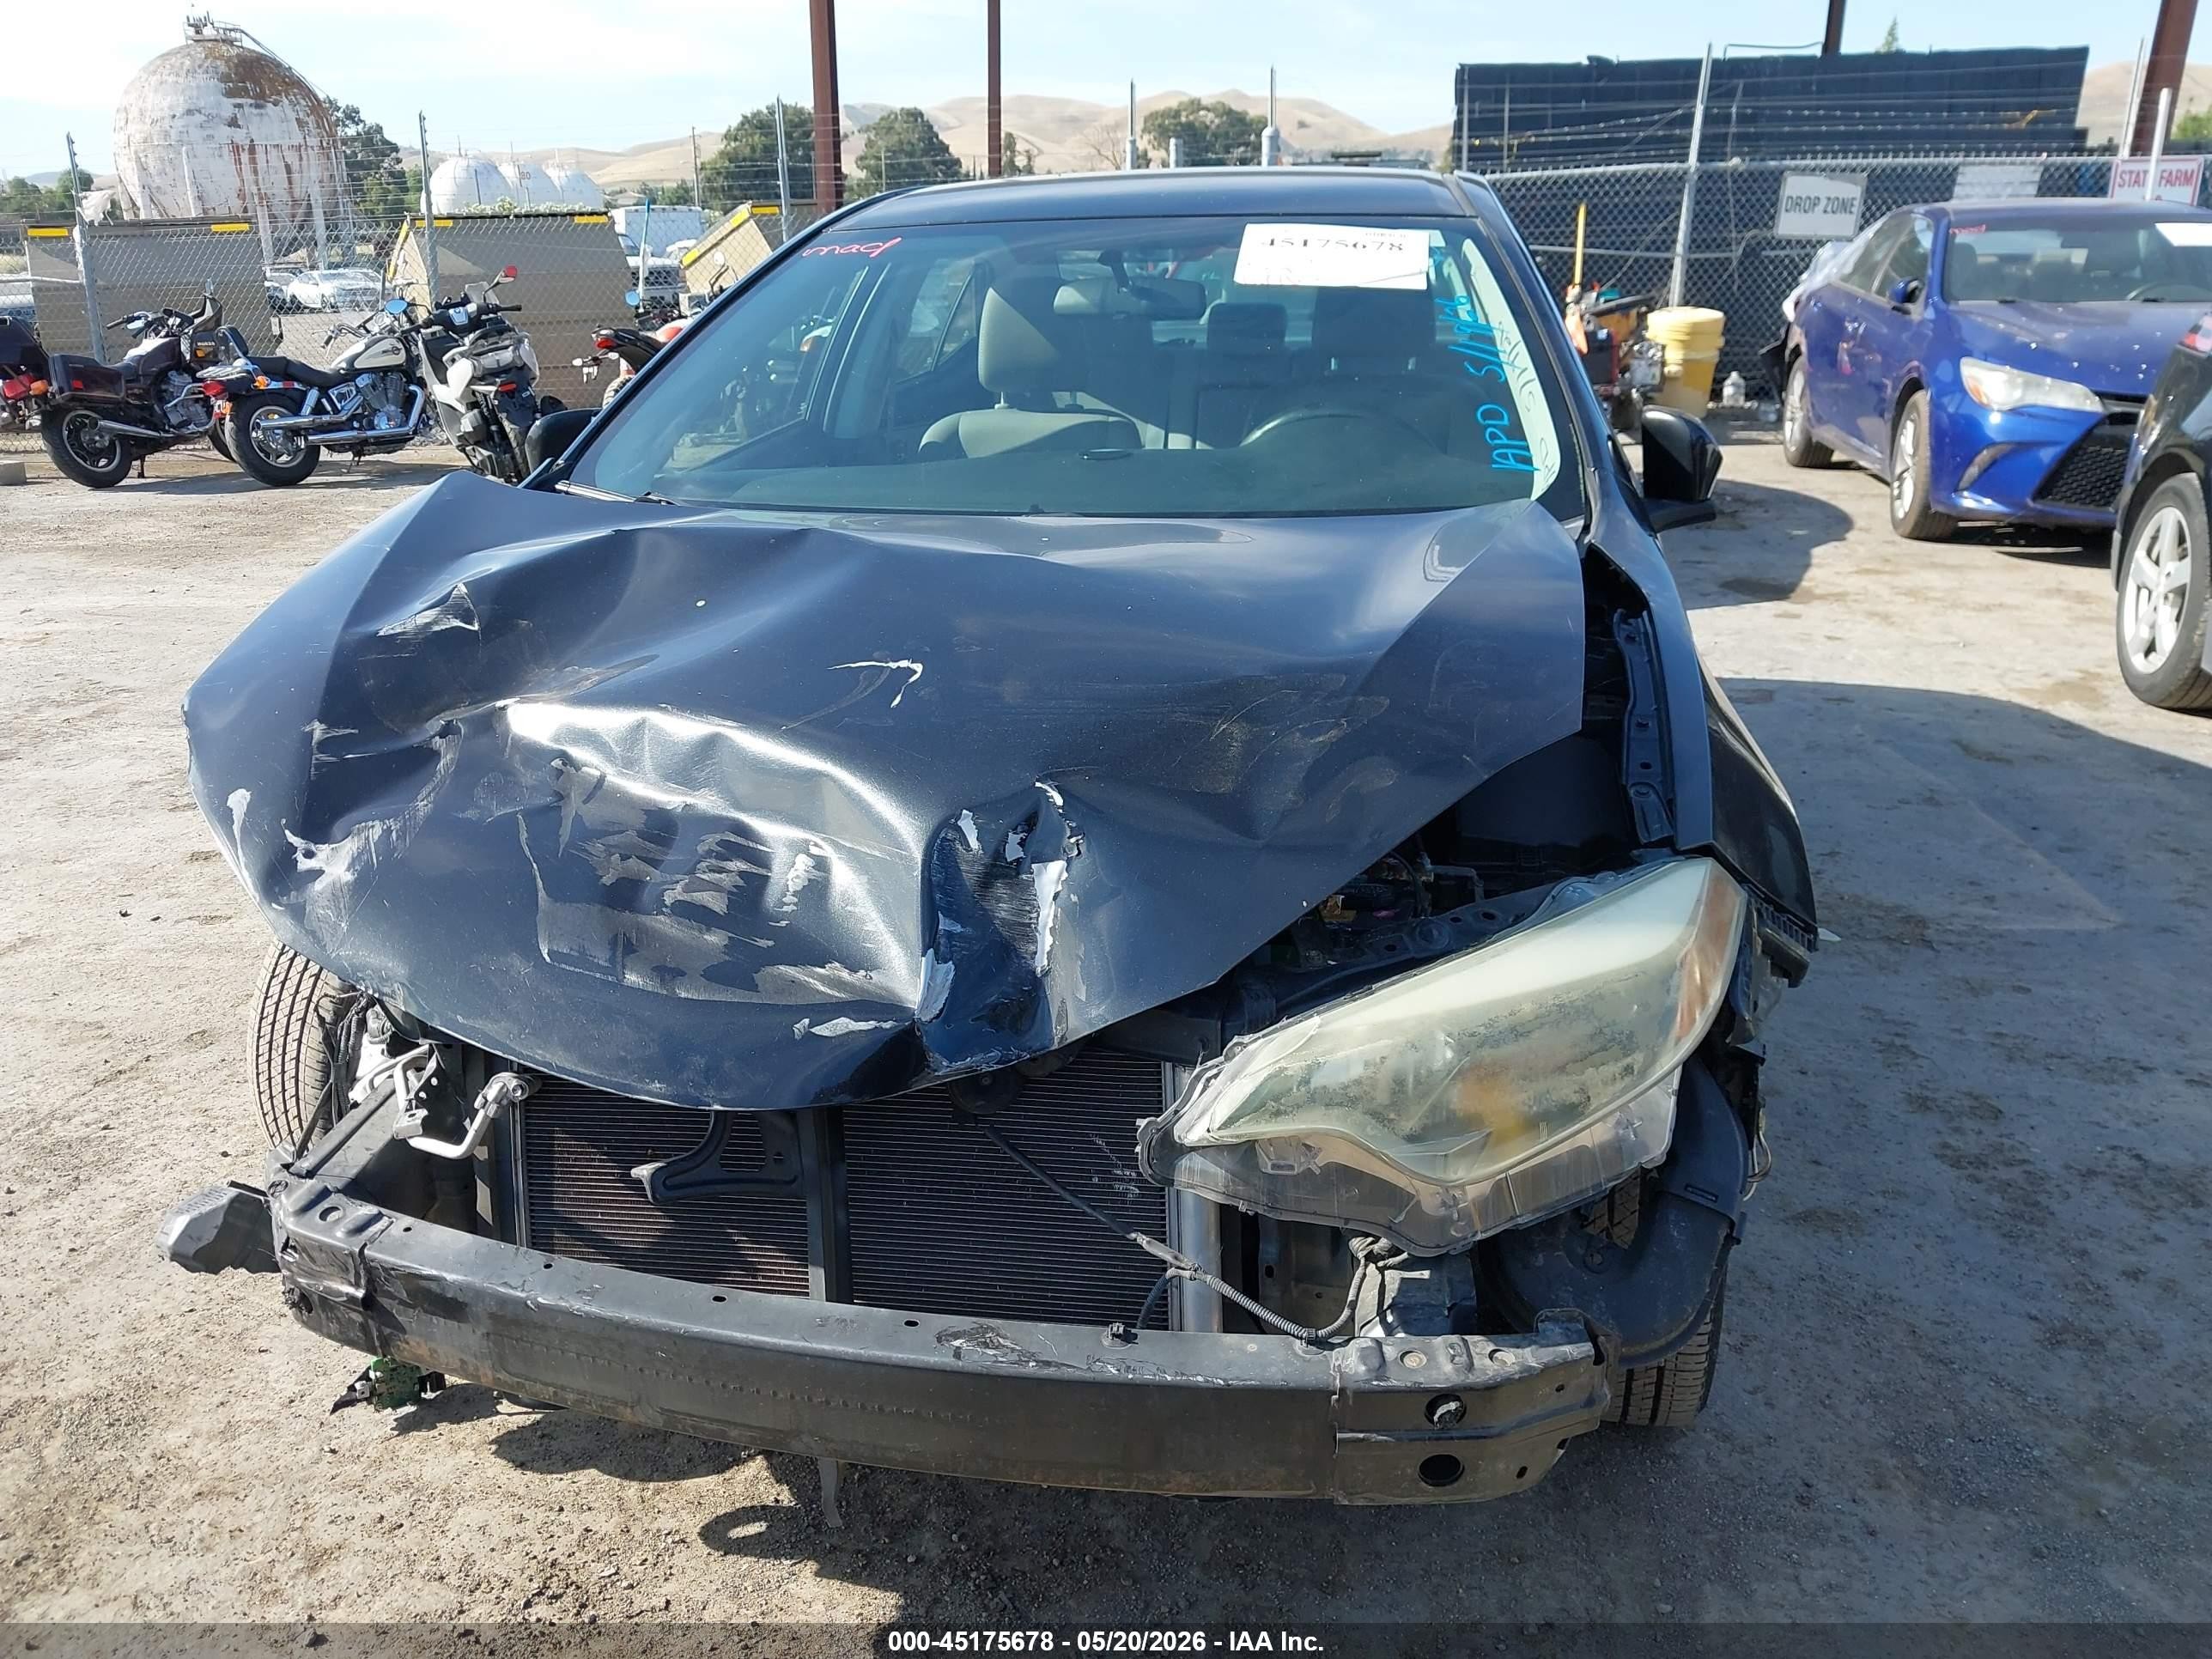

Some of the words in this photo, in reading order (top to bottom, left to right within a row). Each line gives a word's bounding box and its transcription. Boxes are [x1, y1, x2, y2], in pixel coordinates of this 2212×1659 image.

[2118, 169, 2150, 187] STAT
[2159, 168, 2195, 187] FARM
[1784, 196, 1820, 213] DROP
[1822, 196, 1857, 214] ZONE
